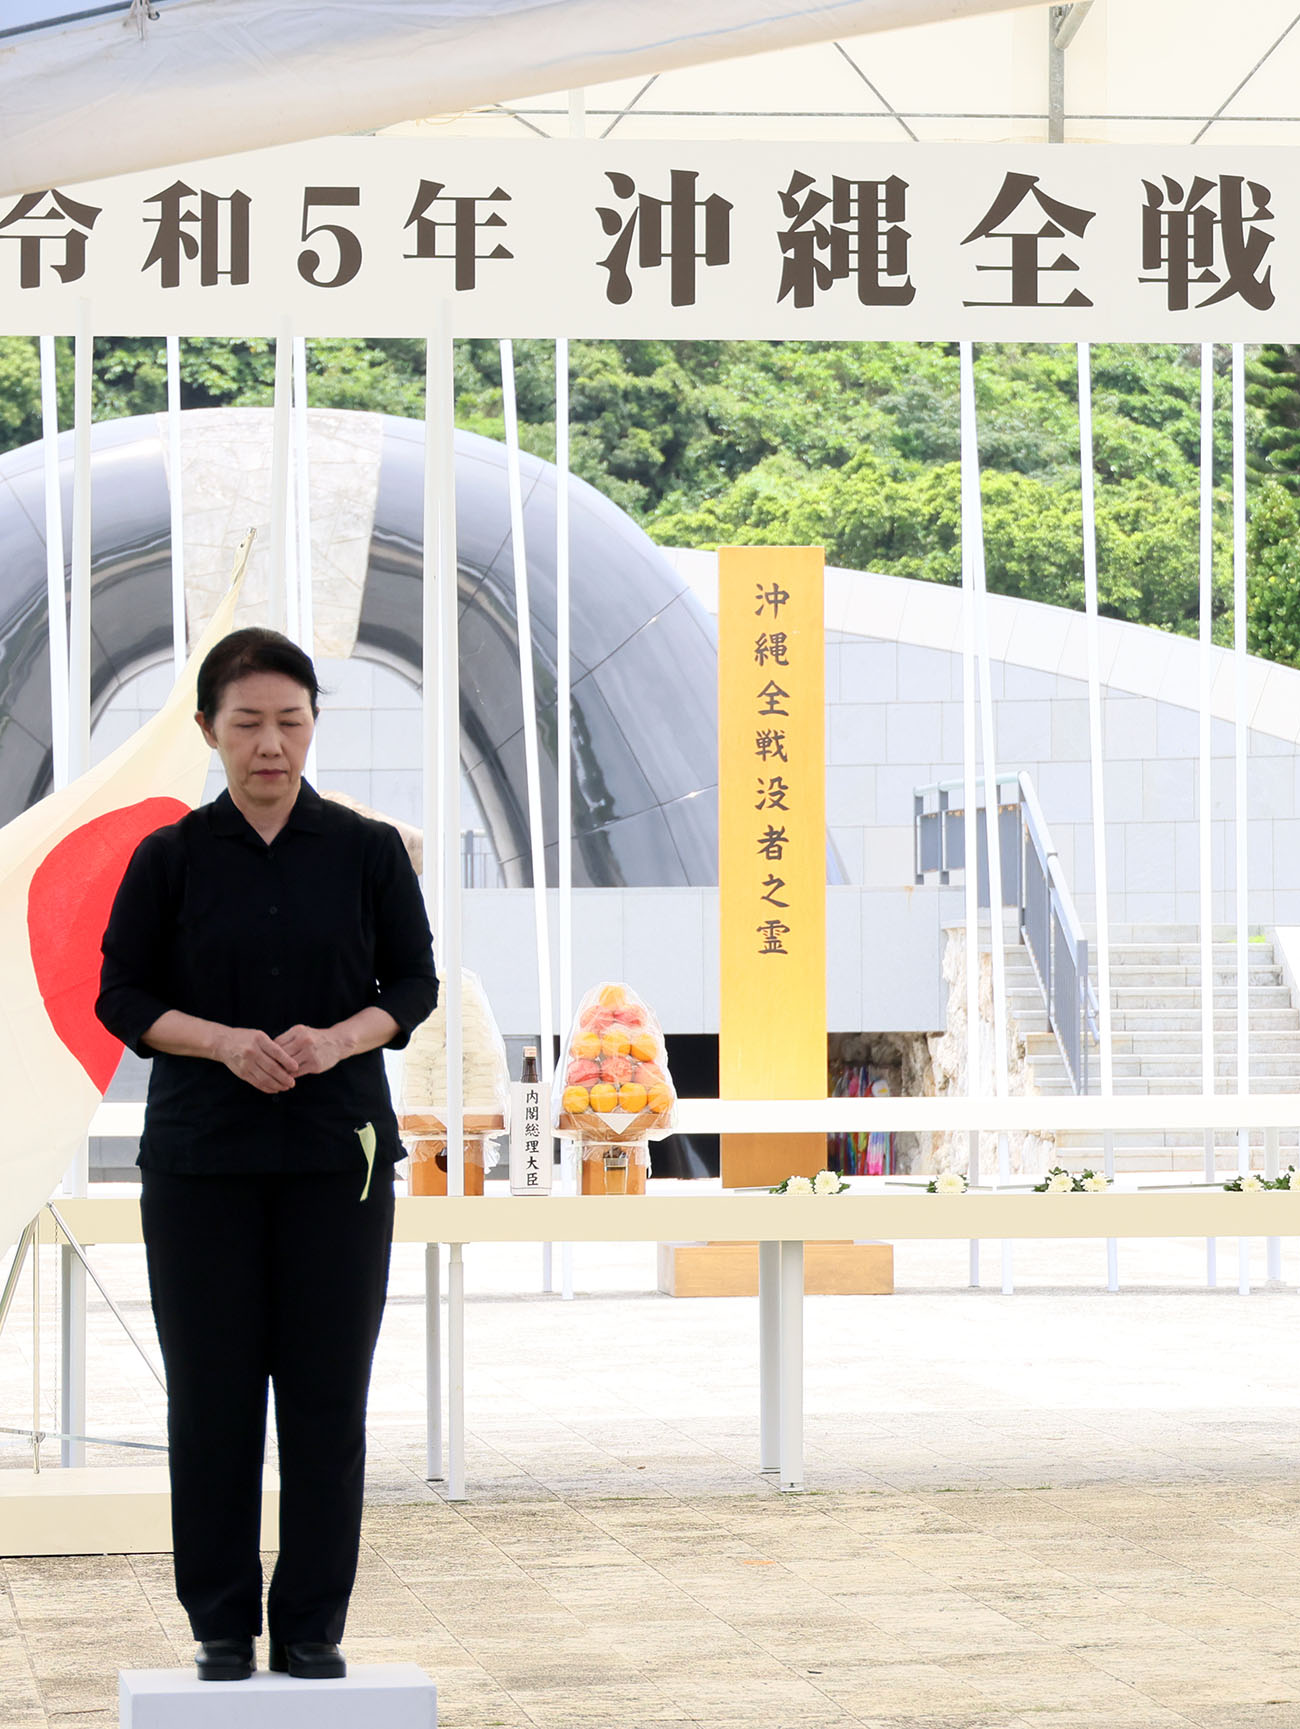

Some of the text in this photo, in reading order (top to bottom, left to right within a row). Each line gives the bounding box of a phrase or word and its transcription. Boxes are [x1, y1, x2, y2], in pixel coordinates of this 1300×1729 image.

[0, 178, 515, 292] 令和5年
[754, 582, 791, 956] 沖縄全戦没者之霊
[525, 1089, 540, 1187] 内閣総理大臣
